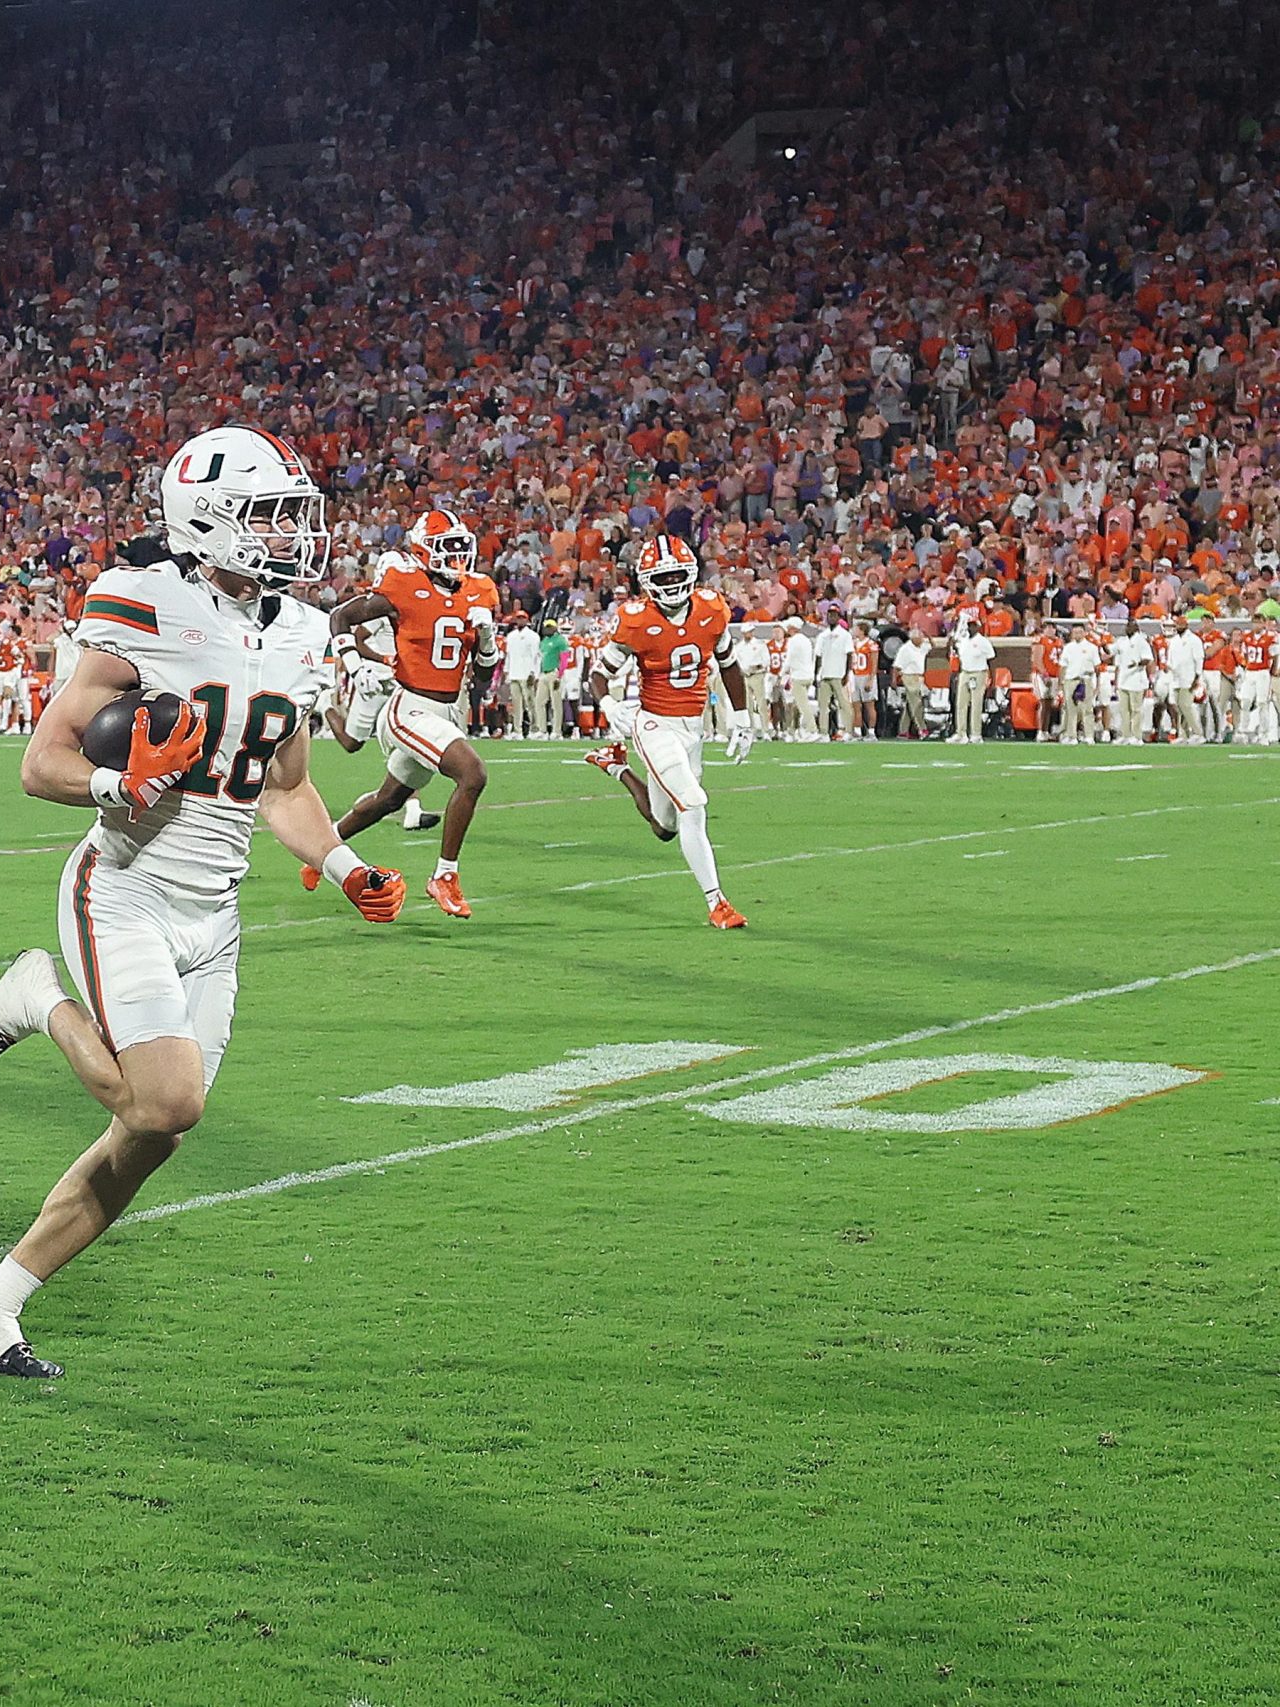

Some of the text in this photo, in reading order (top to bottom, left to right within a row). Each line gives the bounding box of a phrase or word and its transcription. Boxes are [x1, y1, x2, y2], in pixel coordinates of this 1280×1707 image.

[178, 453, 225, 484] U
[182, 632, 203, 642] ACC
[244, 635, 263, 650] U
[431, 615, 465, 670] 6
[670, 642, 702, 689] 8
[173, 681, 298, 803] 18
